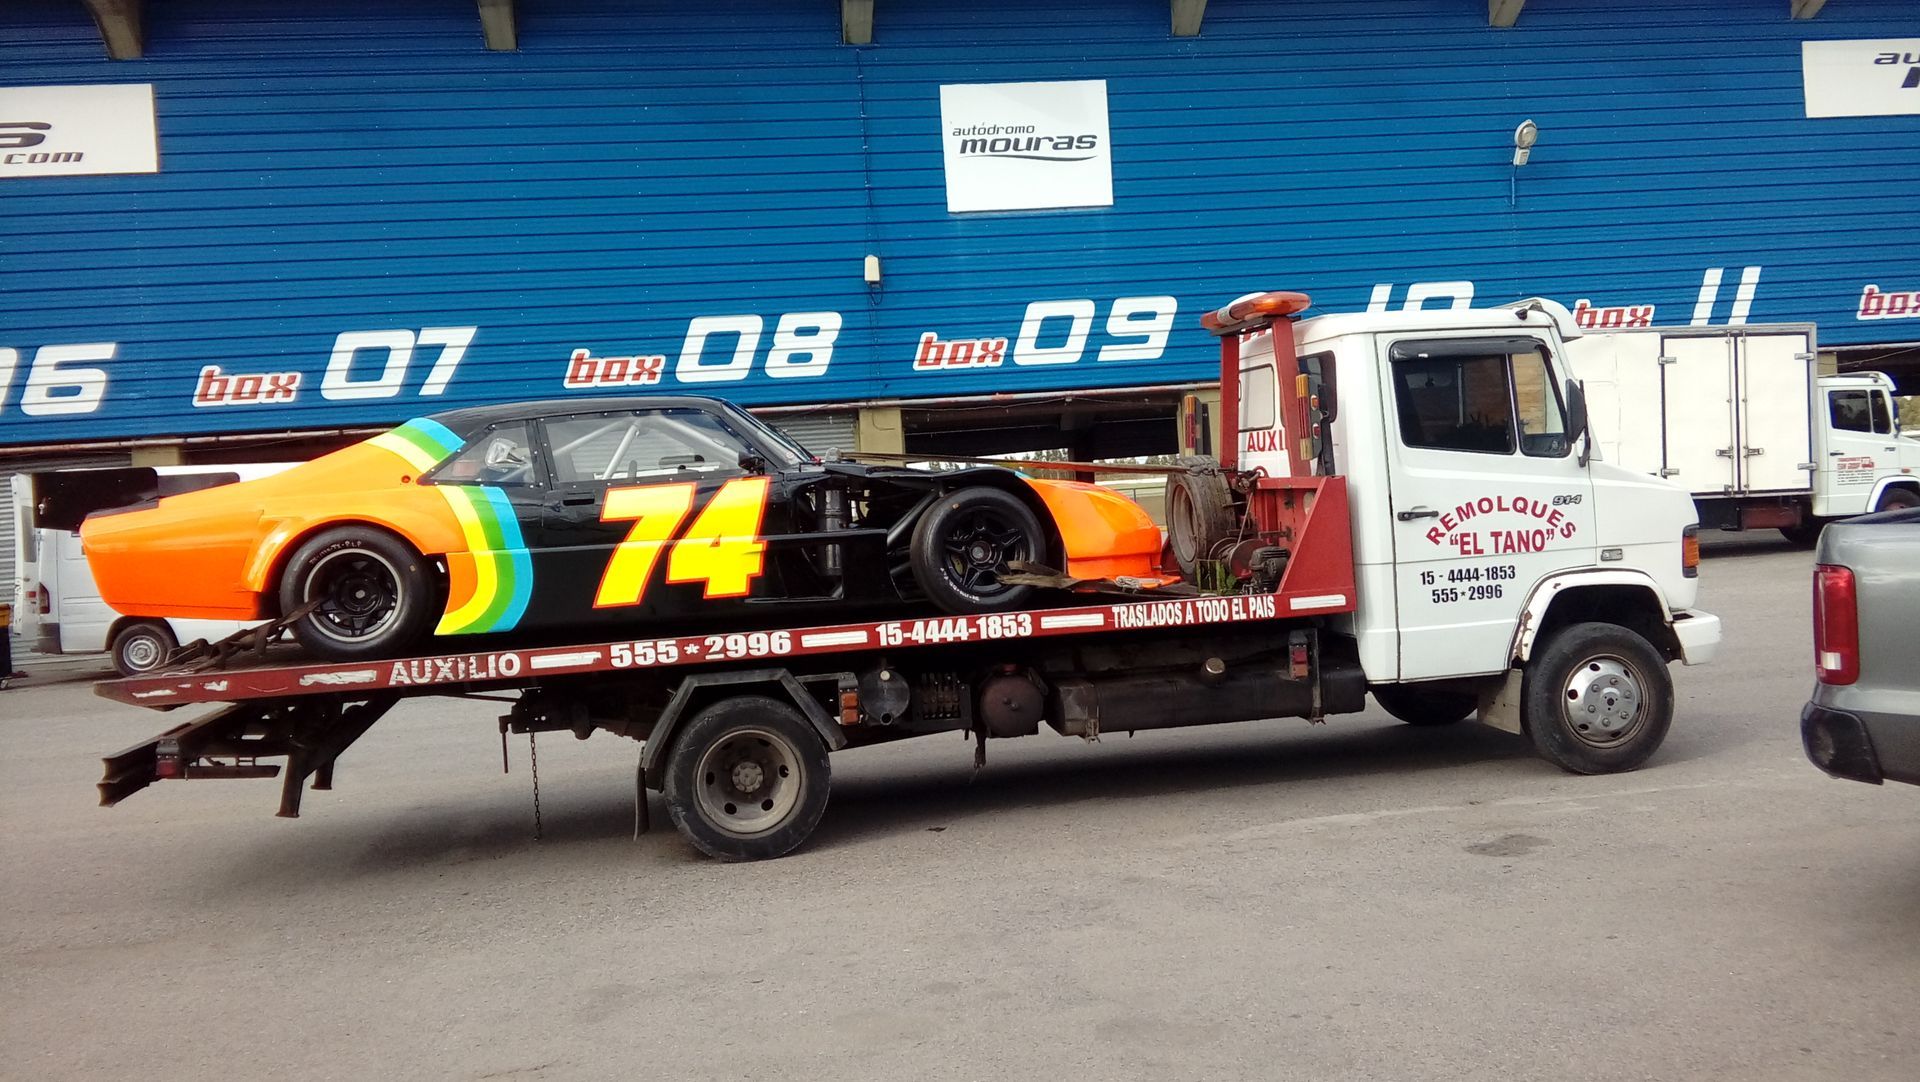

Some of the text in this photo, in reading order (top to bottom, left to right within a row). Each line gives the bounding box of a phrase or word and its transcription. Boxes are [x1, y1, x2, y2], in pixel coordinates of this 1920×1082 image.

[952, 123, 1035, 136] autódromo
[959, 134, 1098, 154] mouras
[563, 311, 843, 389] box 08
[913, 295, 1178, 371] box 09
[0, 341, 116, 416] 6
[192, 325, 478, 408] box 07
[1552, 494, 1582, 506] 914
[1425, 495, 1577, 546] REMOLQUES
[592, 475, 772, 609] 74
[1420, 571, 1435, 586] 15
[1447, 565, 1516, 584] 4444-1853
[1111, 595, 1276, 629] TRASLADOS A TODO EL PAIS
[875, 613, 1033, 647] 15-4444-1853
[388, 652, 521, 686] AUXILIO
